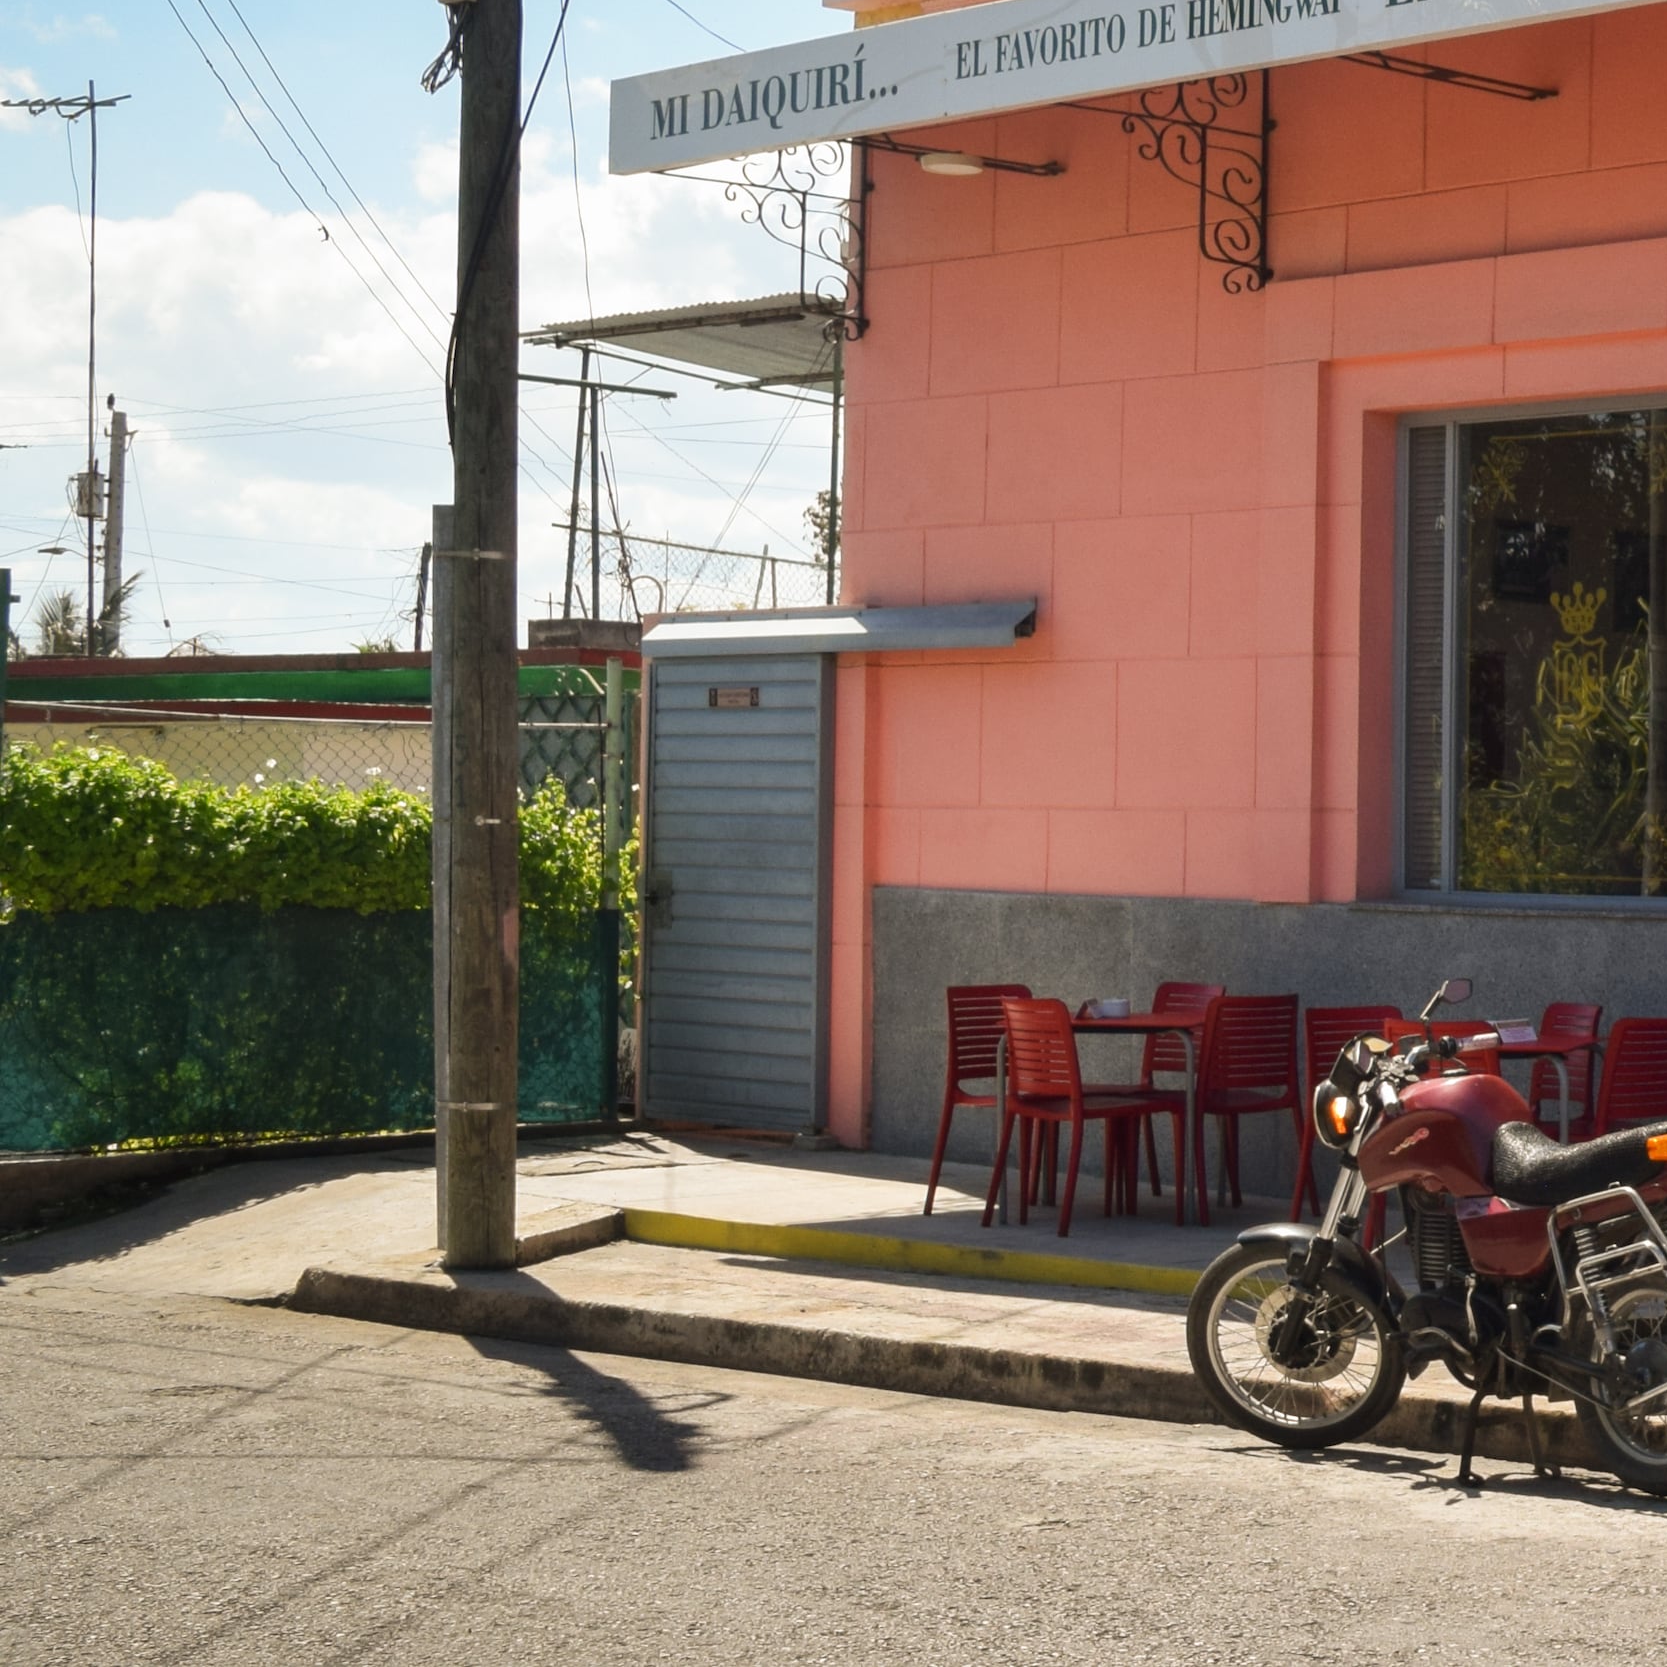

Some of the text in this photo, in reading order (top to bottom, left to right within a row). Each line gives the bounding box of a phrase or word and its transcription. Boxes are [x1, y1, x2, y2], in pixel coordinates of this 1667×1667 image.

[955, 41, 988, 80] EL
[995, 14, 1125, 74] FAVORITO
[1137, 4, 1176, 49] DE
[650, 48, 899, 140] MI DAIQUIRÍ...
